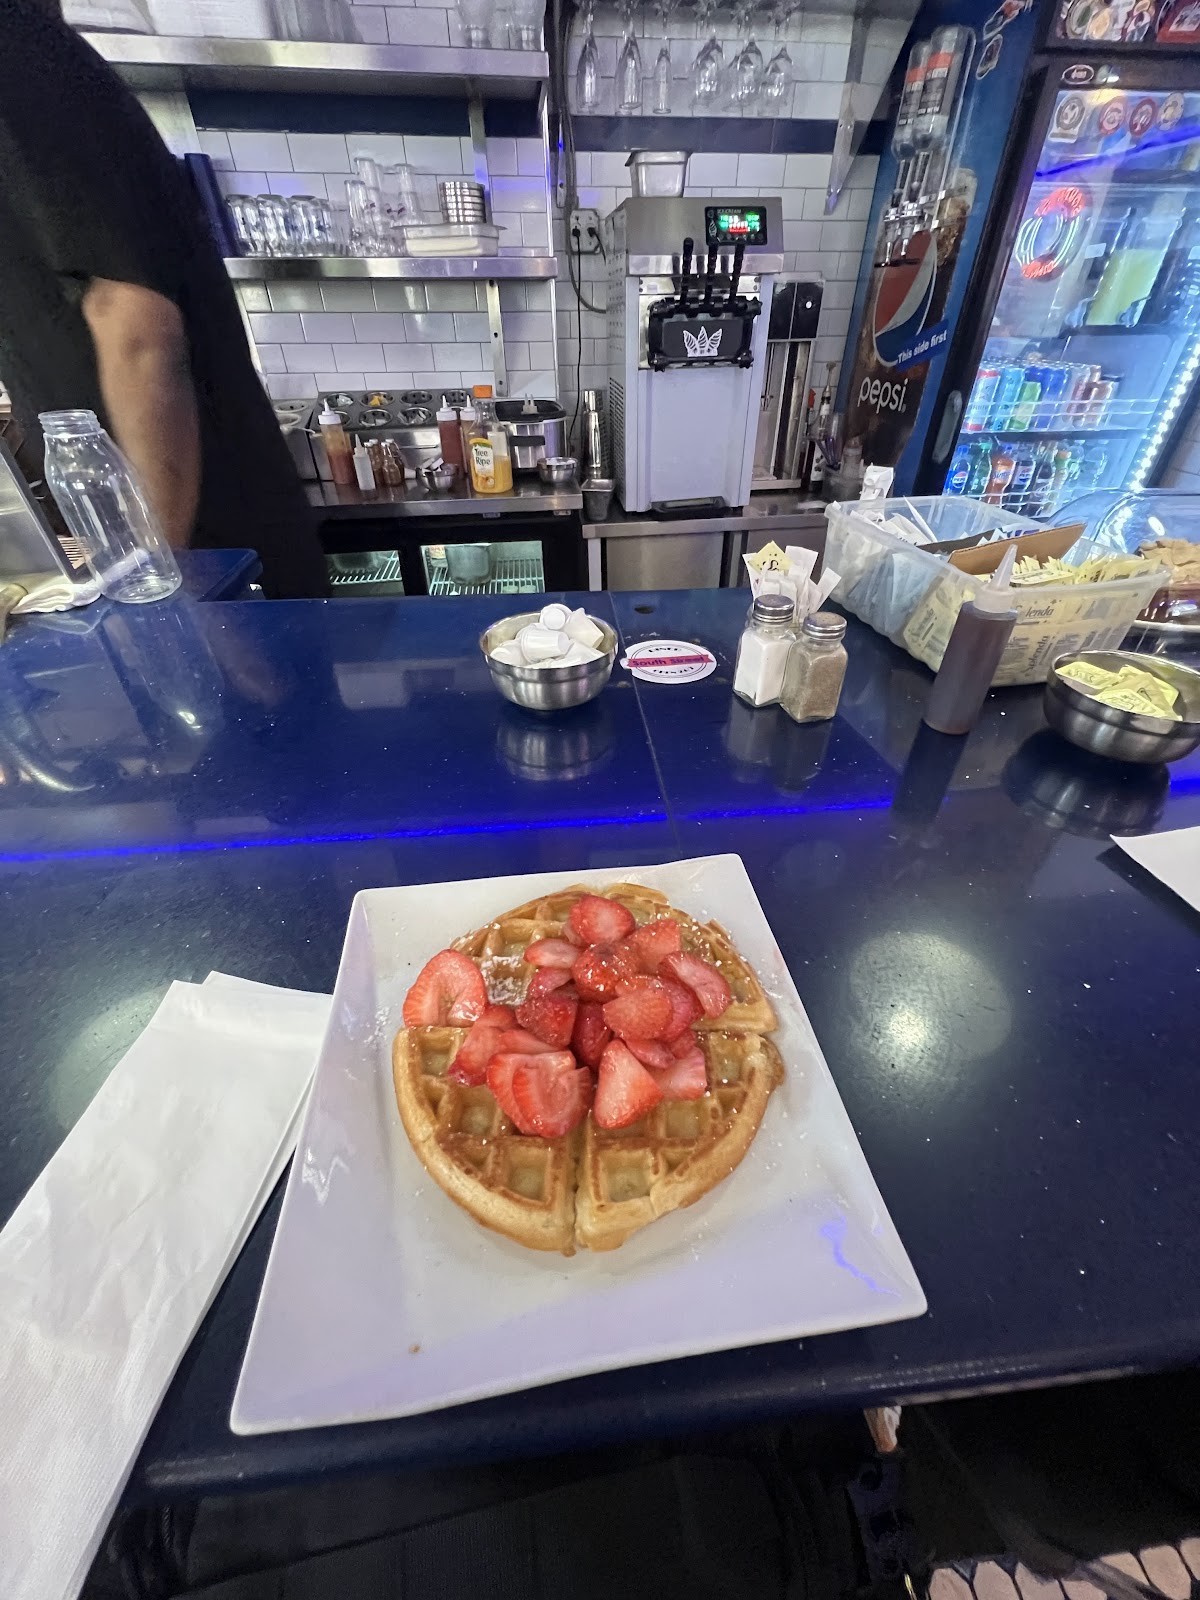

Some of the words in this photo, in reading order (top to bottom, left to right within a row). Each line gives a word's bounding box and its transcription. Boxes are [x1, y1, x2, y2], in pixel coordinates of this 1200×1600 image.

[897, 349, 913, 363] This
[913, 340, 930, 355] side
[930, 330, 947, 347] first
[857, 376, 908, 414] pepsi
[475, 456, 490, 466] Ripe
[1015, 604, 1054, 617] lenda
[632, 659, 667, 667] South
